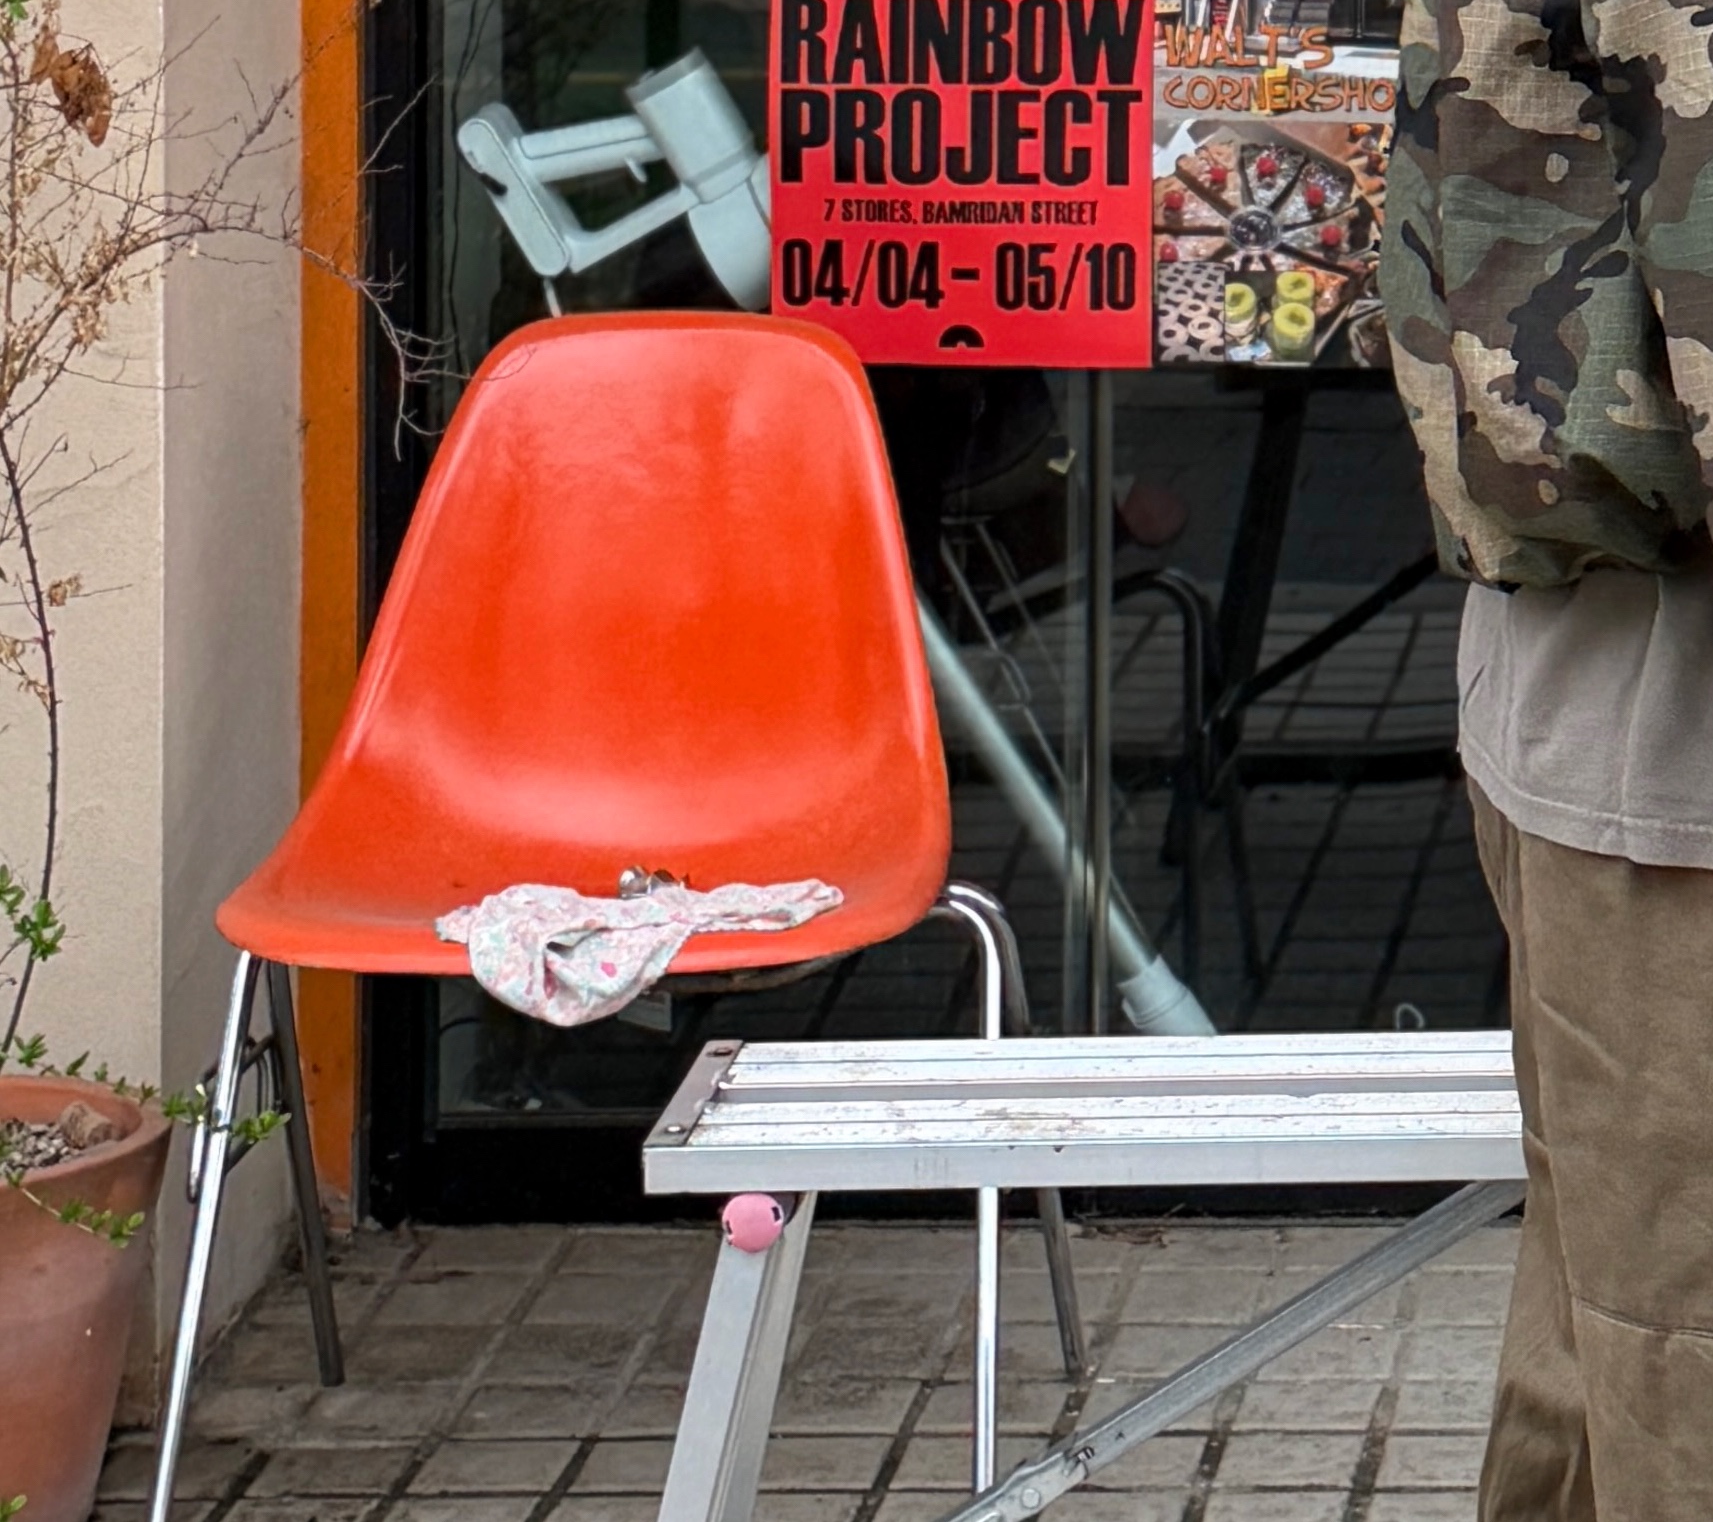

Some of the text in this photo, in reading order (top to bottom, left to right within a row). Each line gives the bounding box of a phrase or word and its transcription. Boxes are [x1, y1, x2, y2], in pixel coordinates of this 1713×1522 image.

[1165, 23, 1334, 69] WALT'S
[1163, 74, 1396, 113] CORNERSHO
[781, 89, 1141, 185] PROJECT
[824, 199, 1097, 226] 7 STORES, BAMRIDAN STREET
[783, 240, 943, 308] 04/04
[996, 243, 1134, 310] 05/10
